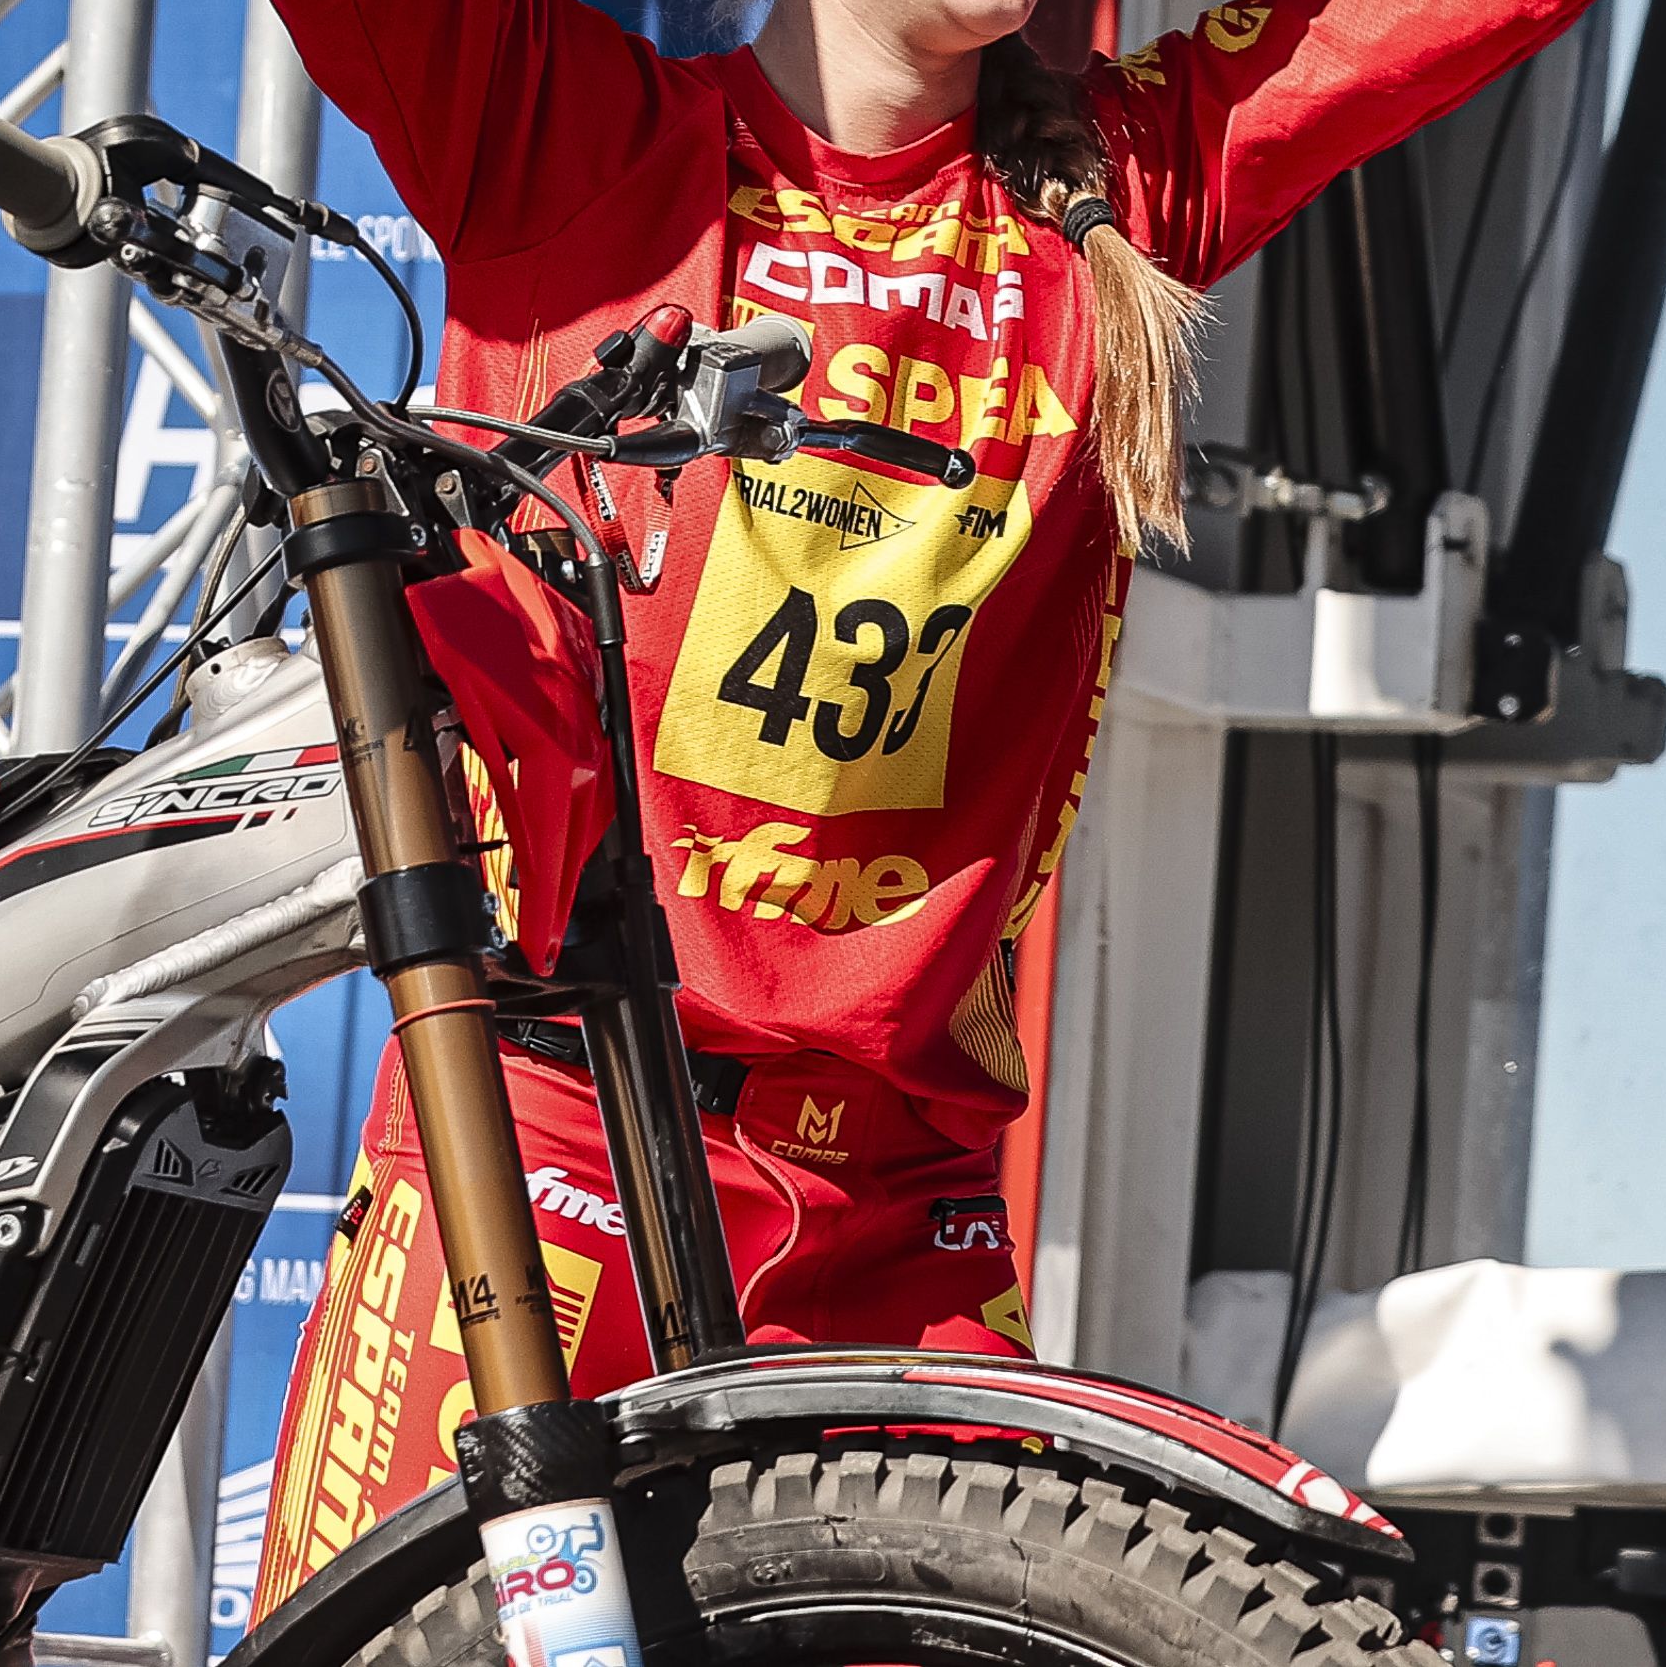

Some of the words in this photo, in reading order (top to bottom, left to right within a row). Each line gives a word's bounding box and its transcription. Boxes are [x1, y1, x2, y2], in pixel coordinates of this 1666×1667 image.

[955, 505, 1007, 539] FIM
[88, 771, 339, 827] SINCRO
[770, 1139, 849, 1165] COMAS
[366, 1329, 415, 1487] TEAM
